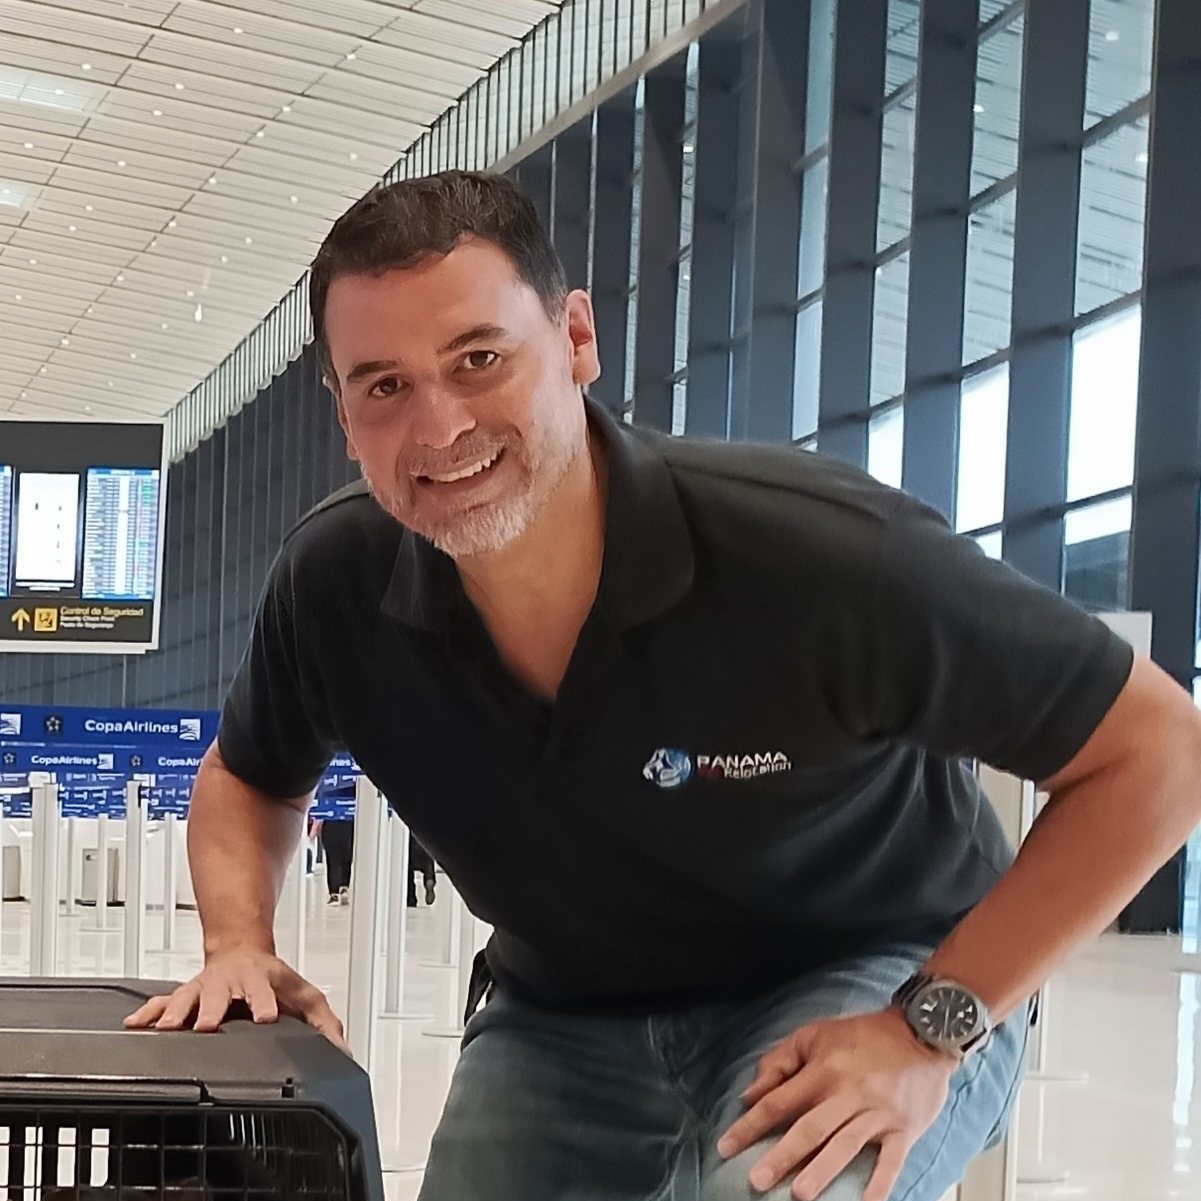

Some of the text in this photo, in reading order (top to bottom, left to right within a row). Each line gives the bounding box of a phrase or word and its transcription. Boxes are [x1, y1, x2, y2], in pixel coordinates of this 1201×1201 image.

[60, 606, 144, 618] Control de Seguridad
[84, 719, 179, 735] CopaAirlines
[31, 754, 98, 767] CopaAirlines
[158, 756, 201, 768] CopaAir
[696, 751, 788, 769] PANAMA
[724, 761, 792, 779] Relocation
